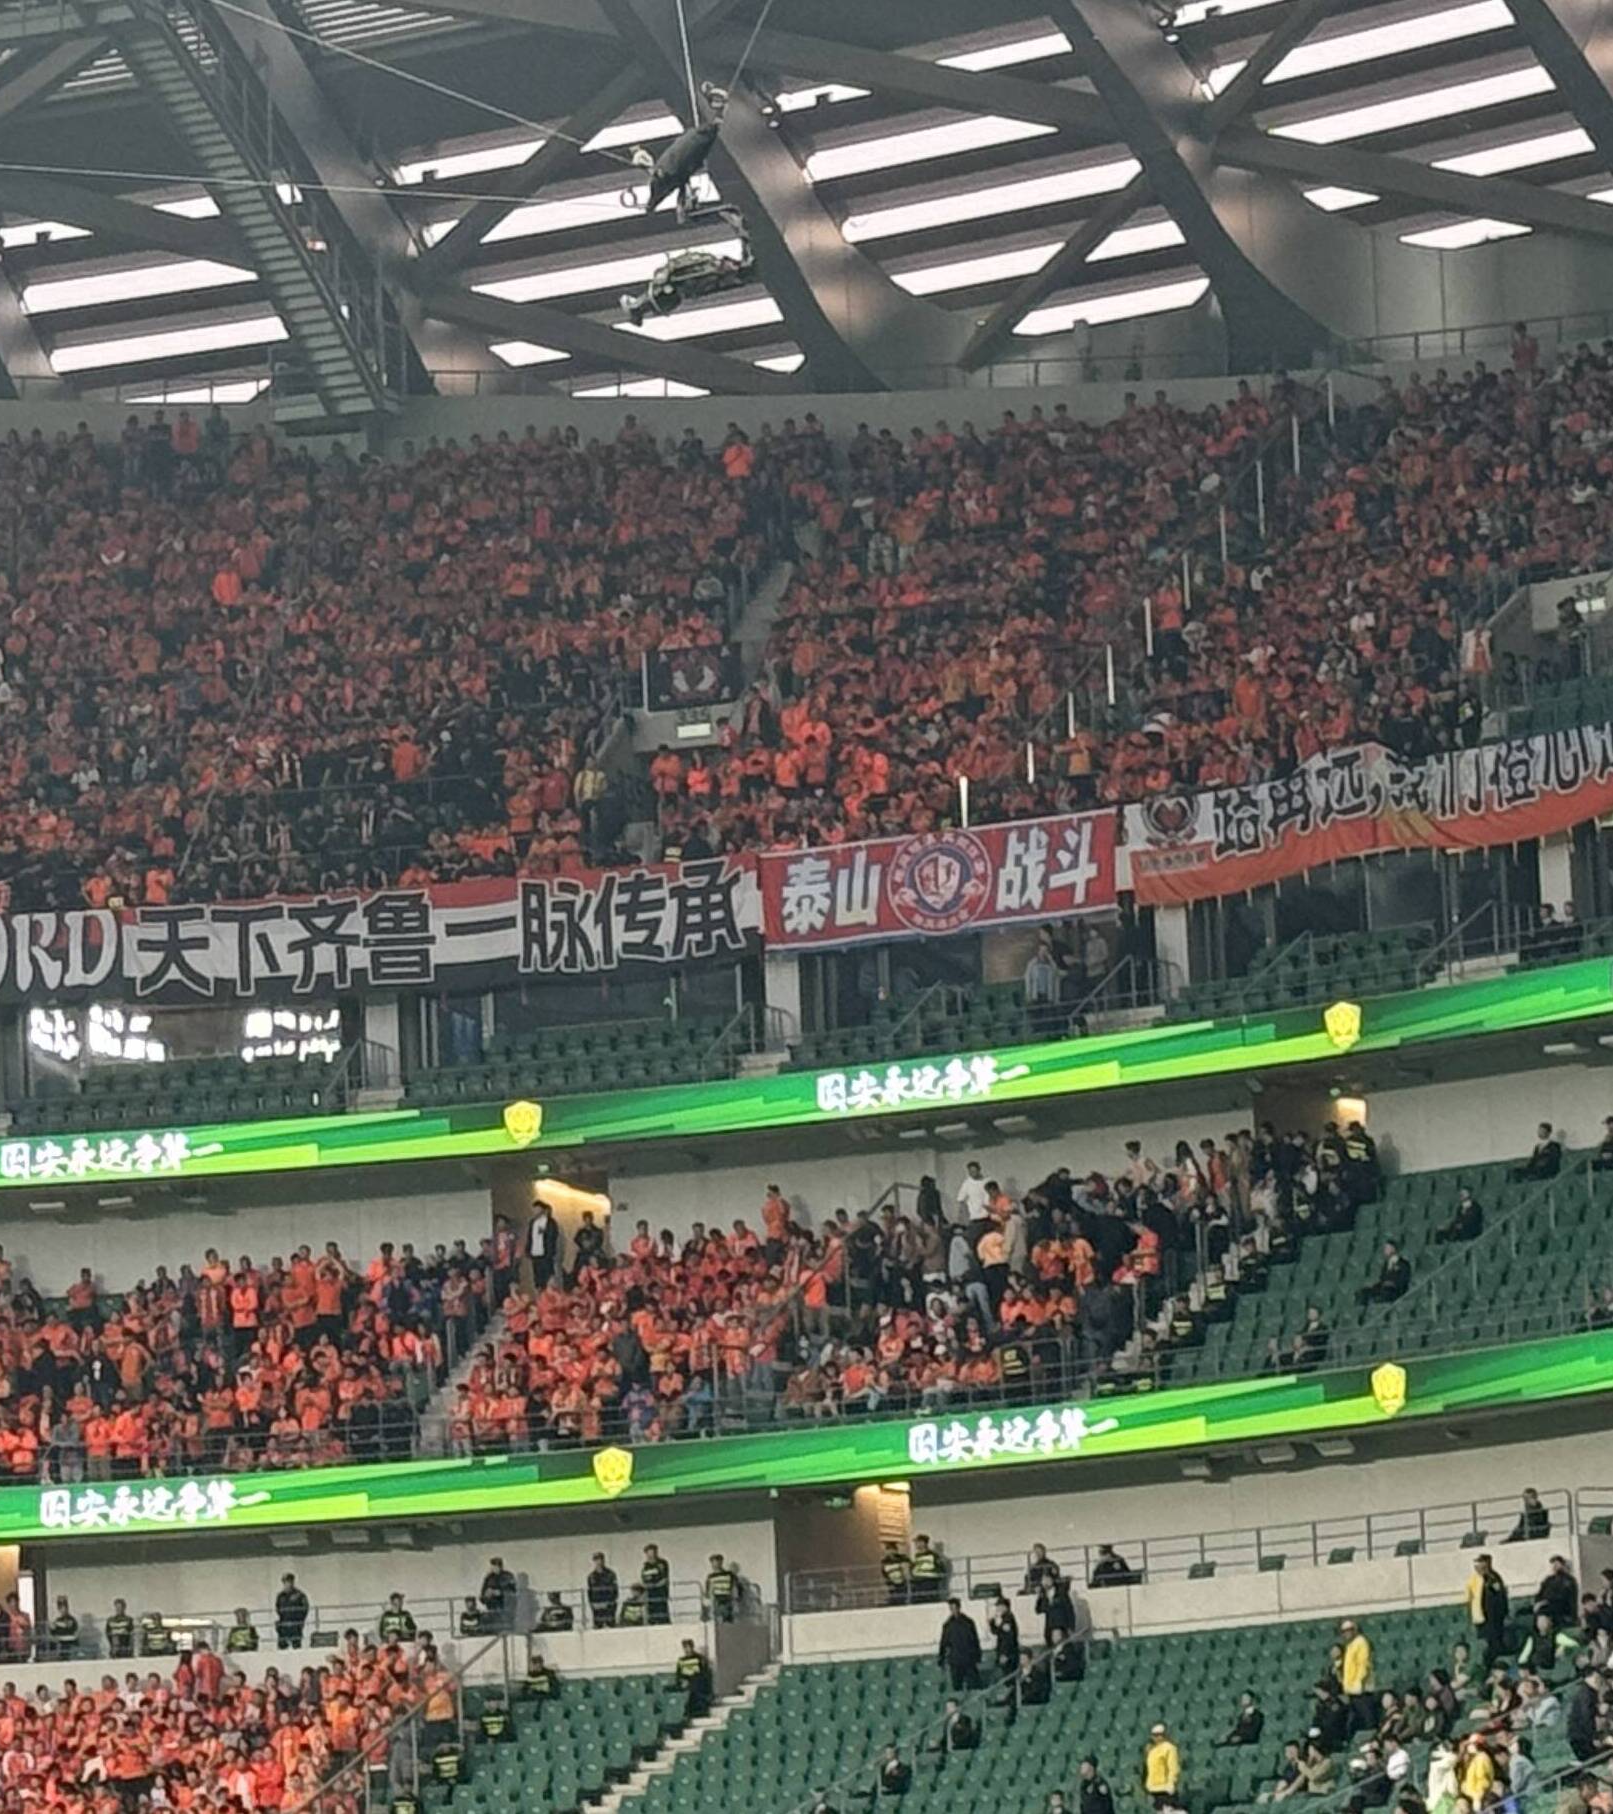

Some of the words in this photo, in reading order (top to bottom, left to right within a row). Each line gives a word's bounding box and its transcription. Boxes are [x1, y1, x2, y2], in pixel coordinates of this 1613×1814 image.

[136, 858, 745, 997] 天下齐鲁一脉传承
[781, 848, 881, 935] 泰山
[996, 820, 1097, 912] 战斗
